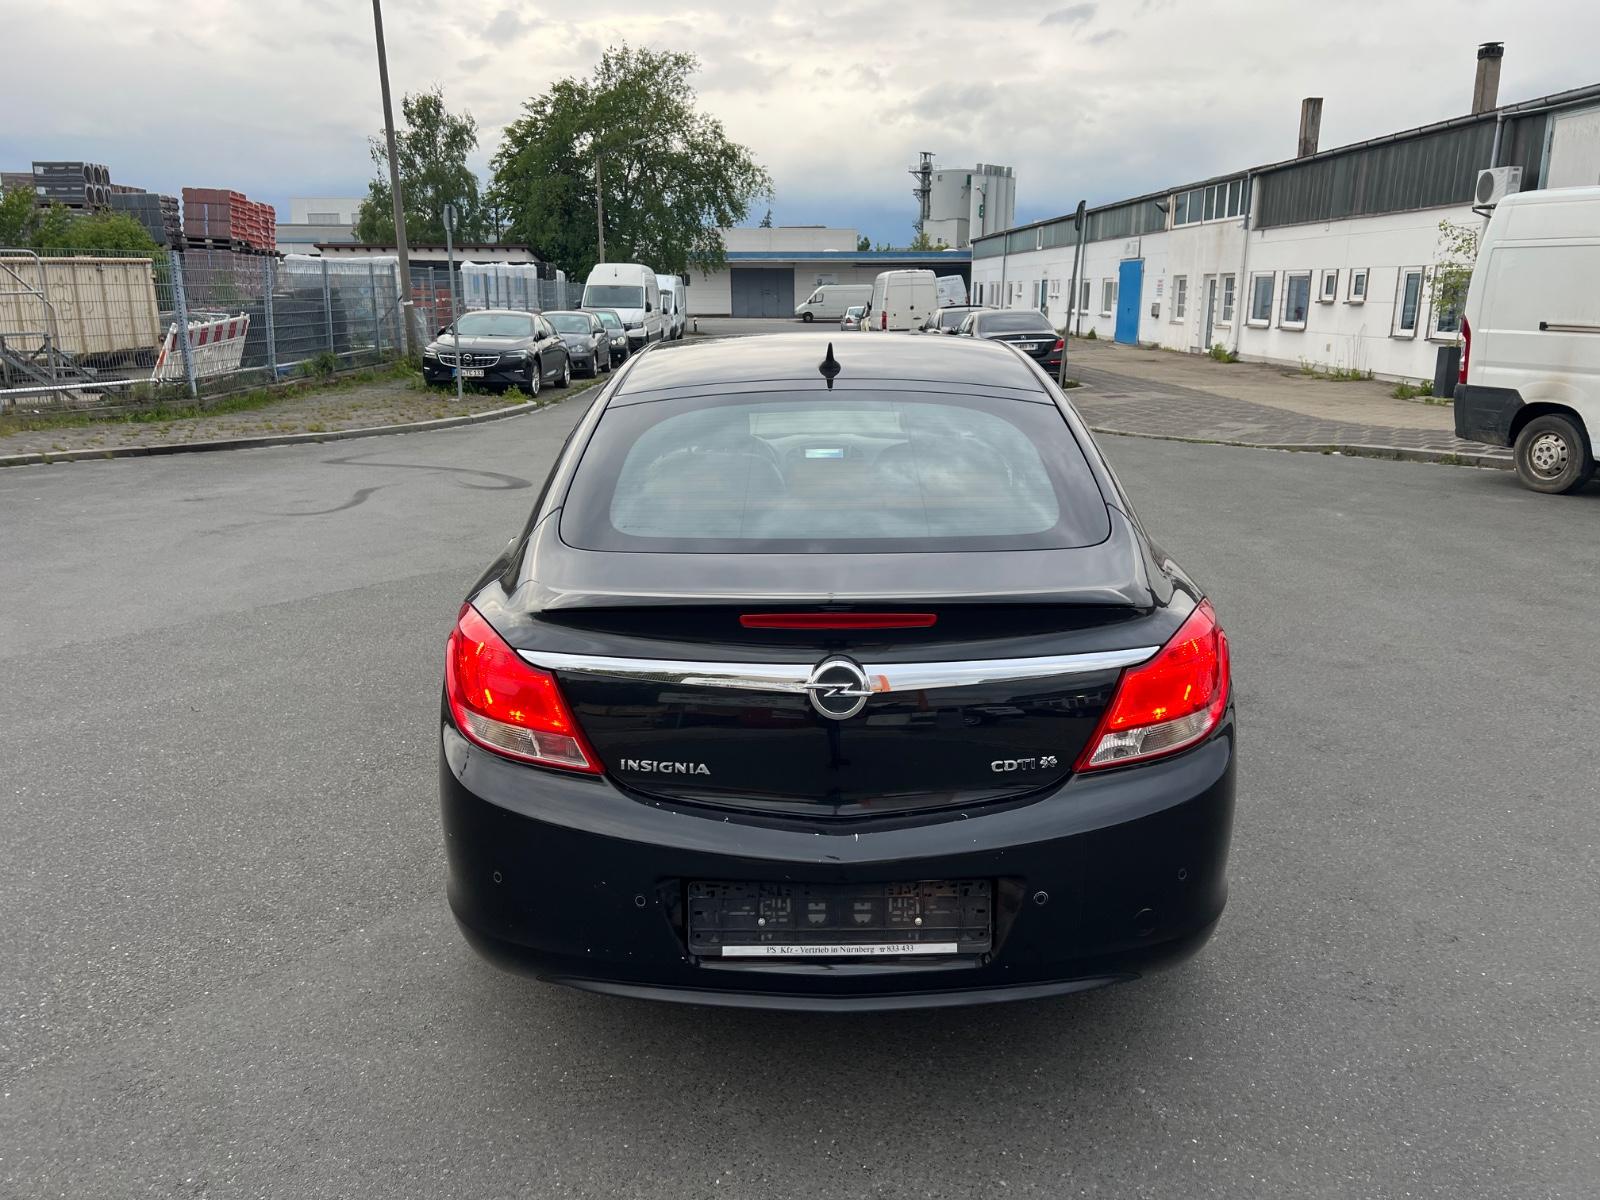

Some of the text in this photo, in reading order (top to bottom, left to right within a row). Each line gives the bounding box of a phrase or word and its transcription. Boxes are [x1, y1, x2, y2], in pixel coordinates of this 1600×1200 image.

[620, 759, 711, 775] INSIGNIA
[991, 758, 1035, 772] CDTI
[766, 946, 777, 954] PS
[780, 946, 794, 954] Kfz
[800, 946, 829, 954] Vertrieb
[830, 946, 838, 954] in
[840, 944, 875, 955] Nürnberg
[886, 945, 900, 953] 833
[901, 944, 914, 953] 433
